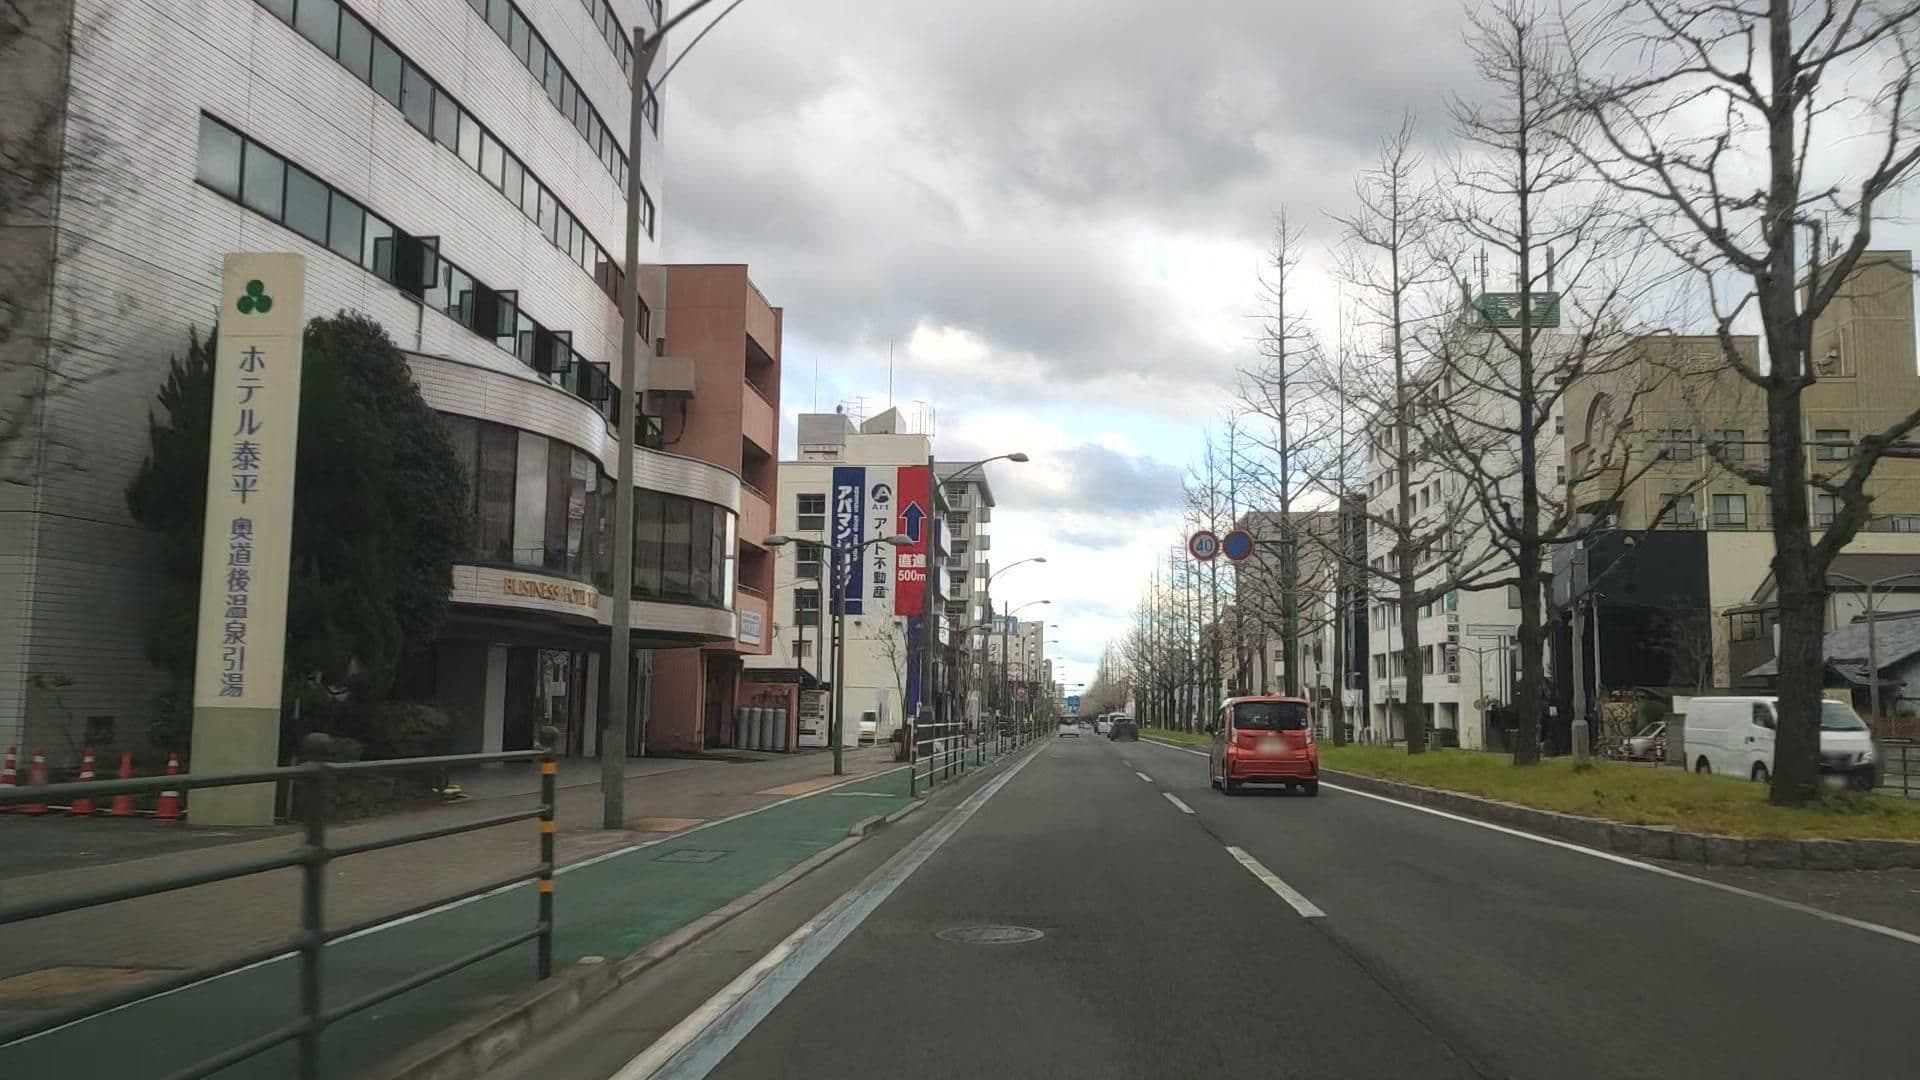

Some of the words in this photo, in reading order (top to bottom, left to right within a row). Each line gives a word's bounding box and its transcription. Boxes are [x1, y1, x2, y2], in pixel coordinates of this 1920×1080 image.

[232, 346, 265, 504] ホテル泰平
[873, 517, 889, 598] アート不動産
[1196, 539, 1213, 552] 40
[898, 553, 926, 568] 直進
[898, 569, 926, 581] 500m
[504, 577, 559, 601] BUSINESS
[219, 516, 253, 697] 奥道後温泉引湯
